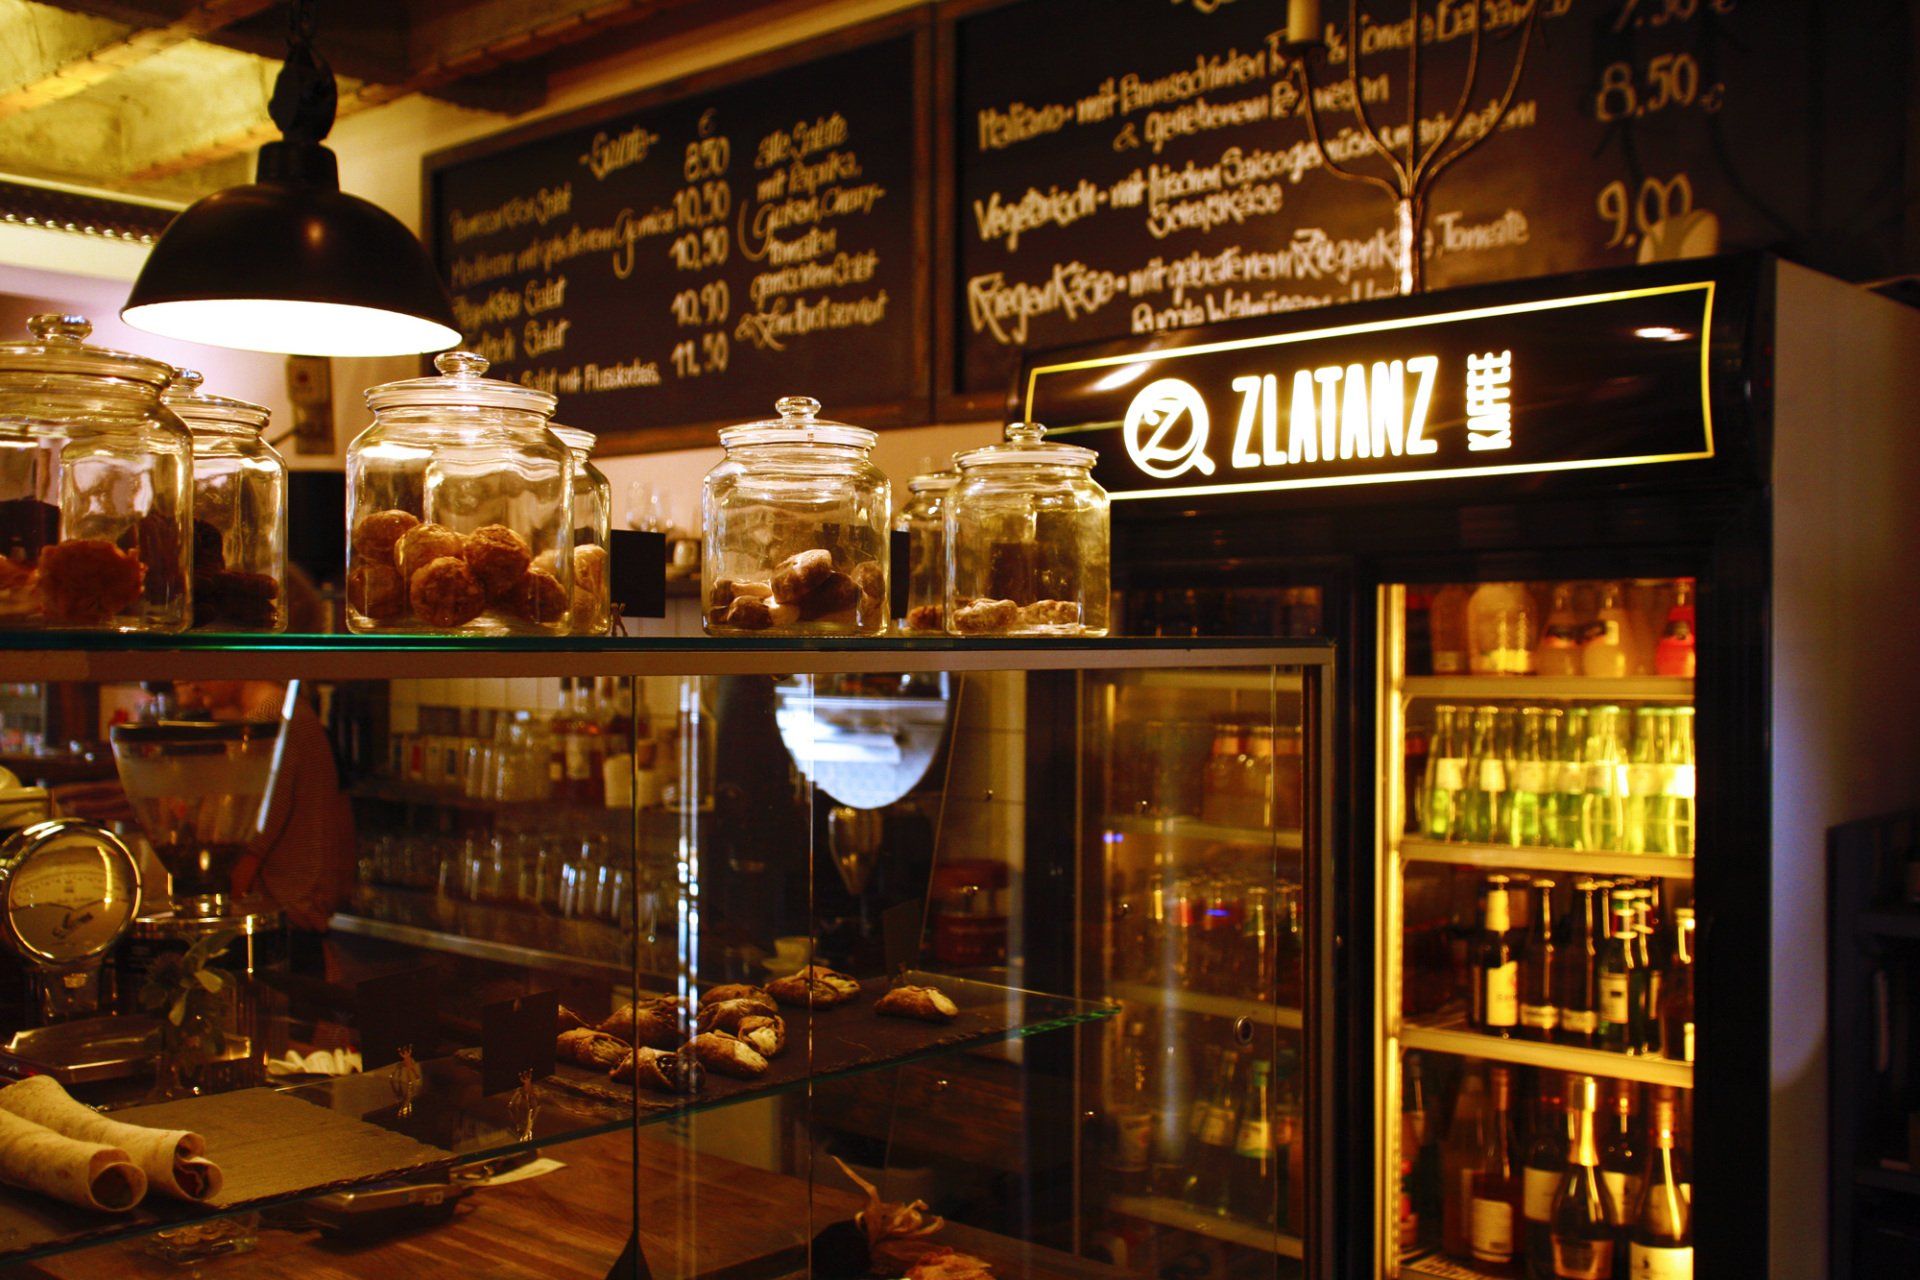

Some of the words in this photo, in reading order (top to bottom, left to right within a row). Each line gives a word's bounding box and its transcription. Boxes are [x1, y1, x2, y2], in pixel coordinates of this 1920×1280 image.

[1595, 50, 1699, 123] 8.50
[668, 330, 731, 380] 11.50
[1231, 355, 1440, 470] ZLATANZ
[1466, 349, 1513, 452] KAFFEE
